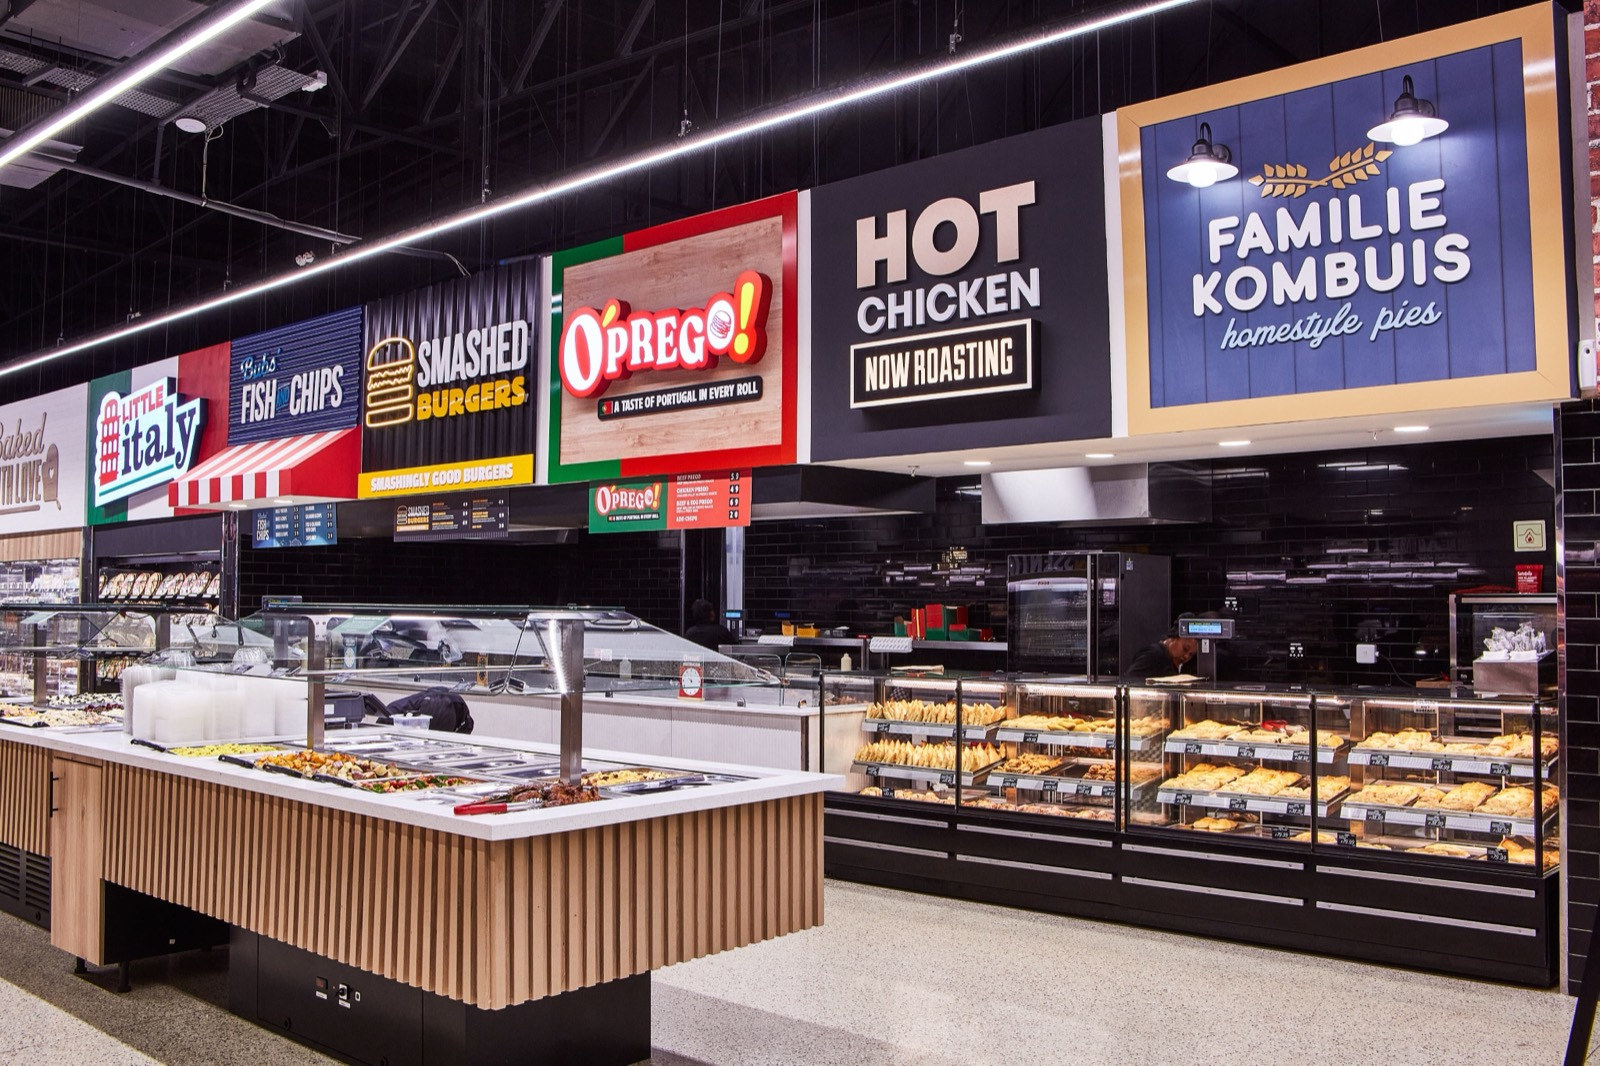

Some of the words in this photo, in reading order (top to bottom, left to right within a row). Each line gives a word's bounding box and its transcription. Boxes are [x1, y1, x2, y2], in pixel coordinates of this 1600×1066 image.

[856, 180, 1035, 289] HOT
[1208, 178, 1447, 264] FAMILIE
[857, 267, 1040, 334] CHICKEN
[1193, 233, 1471, 316] KOMBUIS
[1220, 301, 1362, 349] homestyle
[1369, 300, 1442, 341] pies
[417, 320, 528, 388] SMASHED
[865, 351, 910, 392] NOW
[914, 337, 1014, 386] ROASTING
[122, 384, 163, 423] LITTLE
[241, 379, 277, 424] FISH
[276, 386, 290, 407] AND
[290, 365, 344, 416] CHIPS
[417, 376, 525, 421] BURGERS
[614, 401, 620, 413] A
[621, 398, 644, 412] TASTE
[645, 397, 656, 408] OF
[656, 390, 698, 407] PORTUGAL
[699, 388, 708, 401] IN
[709, 384, 736, 400] EVERY
[737, 381, 759, 396] ROLL
[122, 402, 196, 476] italy
[15, 459, 43, 504] LOVE
[371, 472, 430, 492] SMASHINGLY
[431, 469, 461, 485] GOOD
[463, 463, 514, 483] BURGERS
[408, 505, 430, 517] SMASHED
